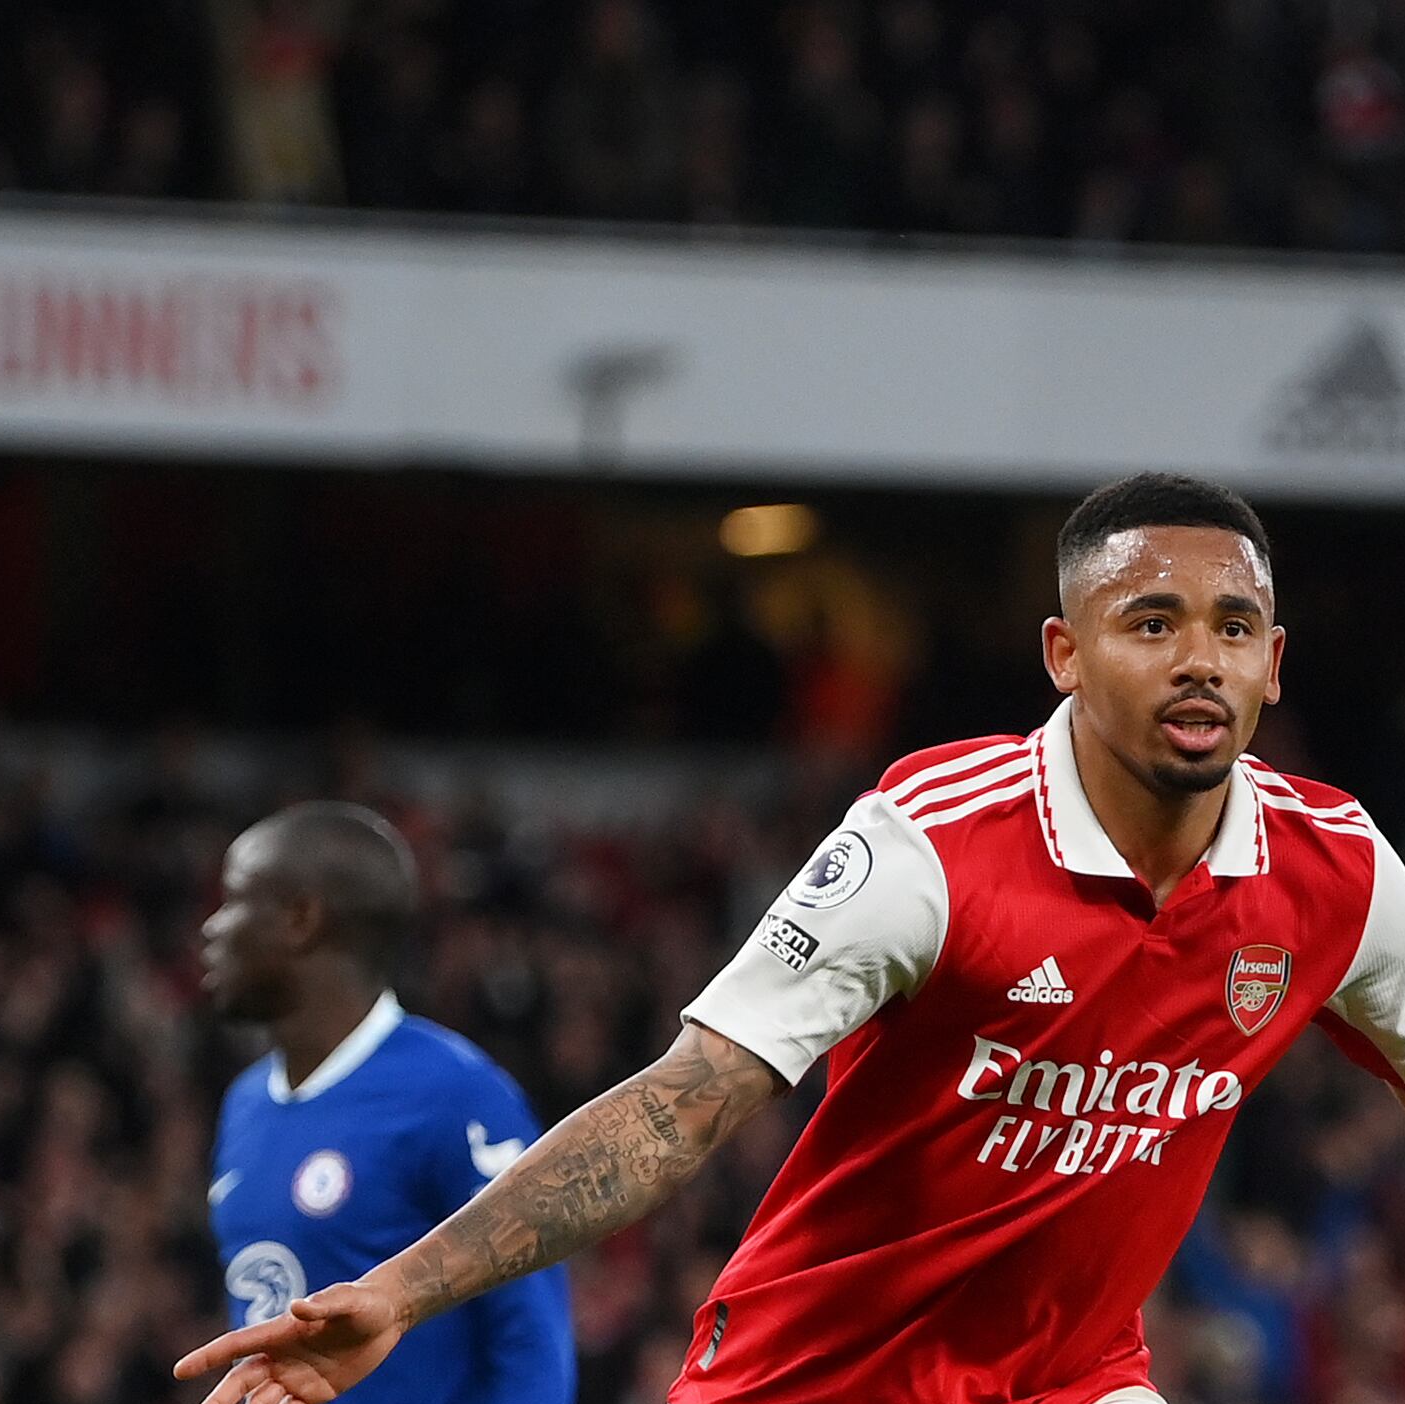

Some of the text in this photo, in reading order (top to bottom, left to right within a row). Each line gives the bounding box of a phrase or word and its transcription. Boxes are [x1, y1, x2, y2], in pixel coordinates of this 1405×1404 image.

[1236, 958, 1282, 975] Arsenal
[1007, 986, 1074, 1004] adidas
[957, 1034, 1243, 1120] Emirate
[976, 1115, 1063, 1173] FLY
